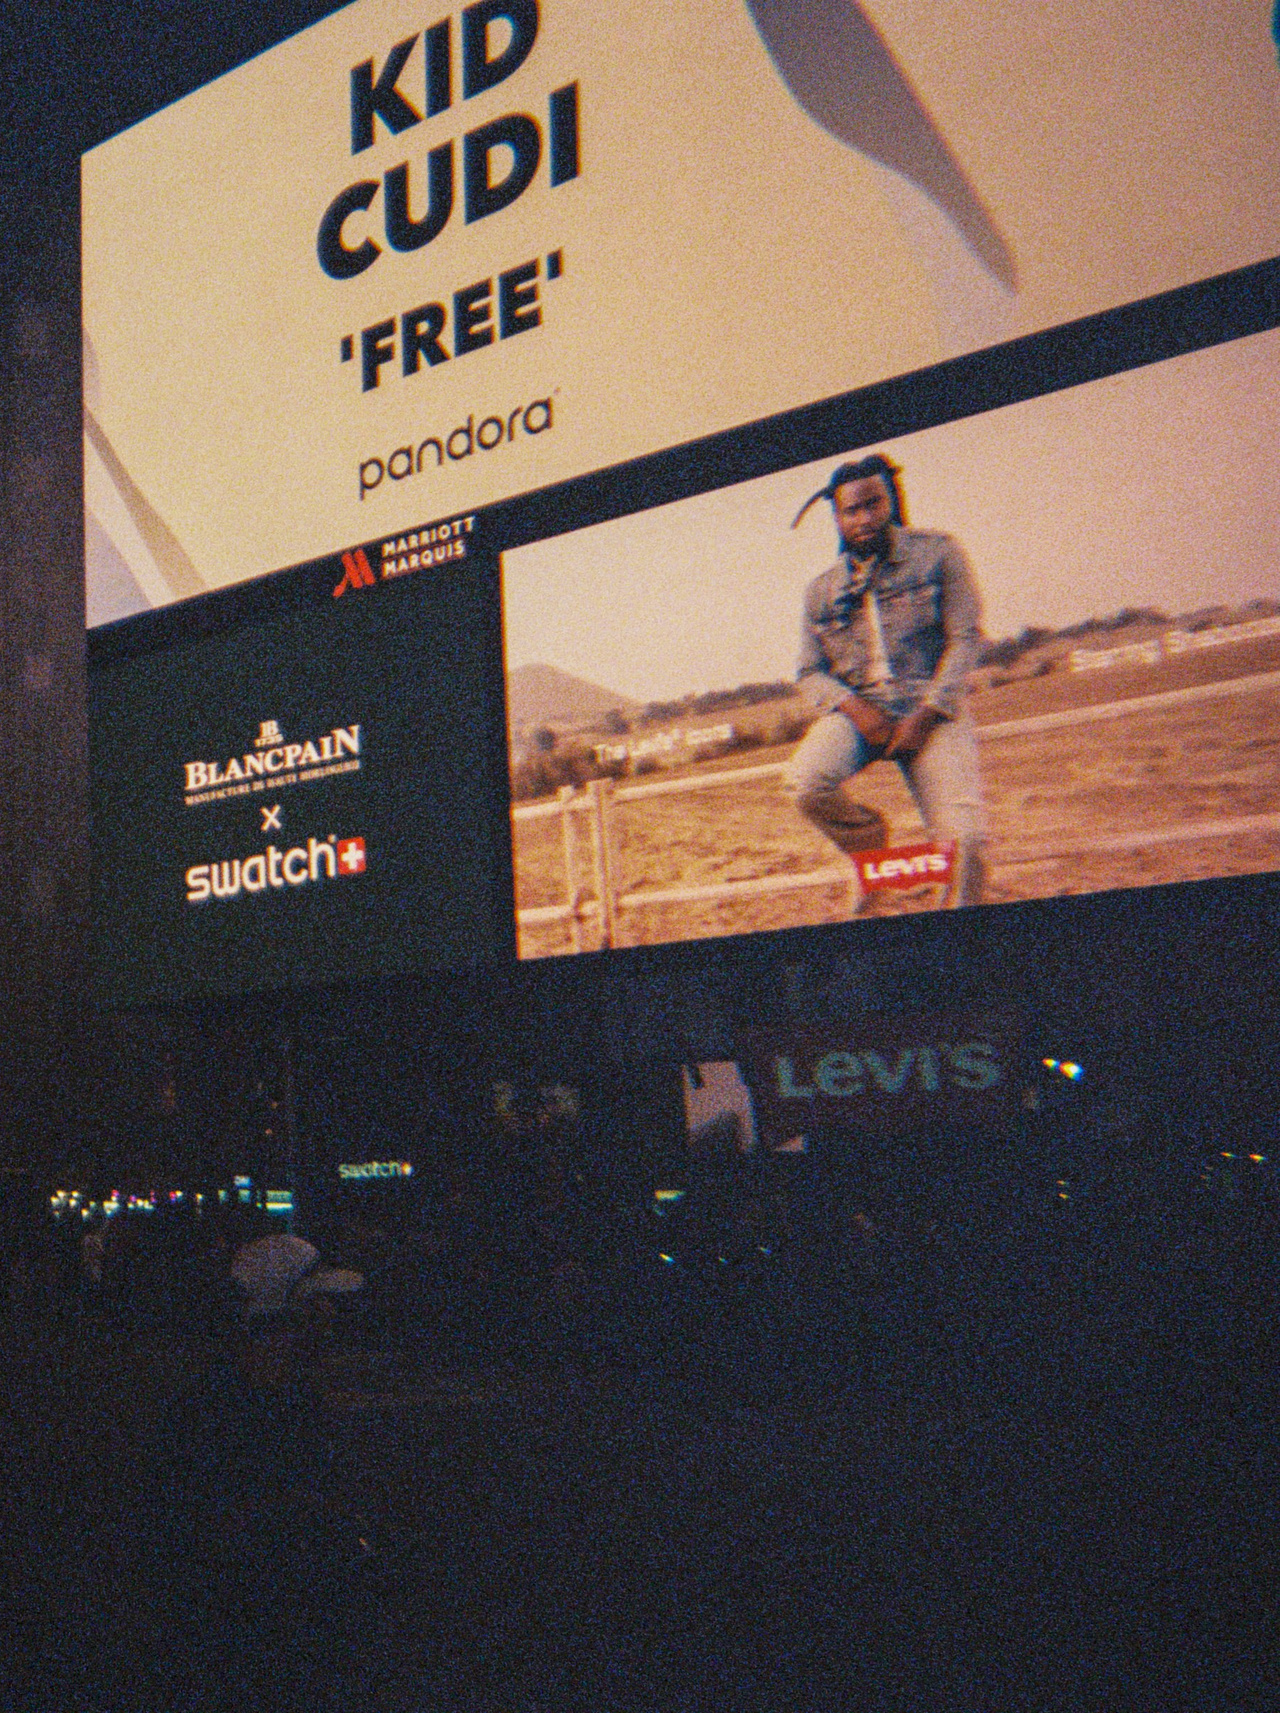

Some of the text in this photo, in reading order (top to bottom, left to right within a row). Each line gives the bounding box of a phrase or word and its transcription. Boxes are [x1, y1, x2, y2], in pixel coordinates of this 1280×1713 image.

[350, 0, 540, 156] KID
[317, 79, 580, 280] CUDI
[340, 247, 564, 393] 'FREE'
[358, 395, 554, 500] pandora
[381, 516, 475, 558] MARRIOTT
[381, 539, 465, 578] MARQUIS
[184, 724, 361, 790] BLANCPAIN
[184, 837, 336, 902] swatch
[338, 1161, 402, 1179] swatch
